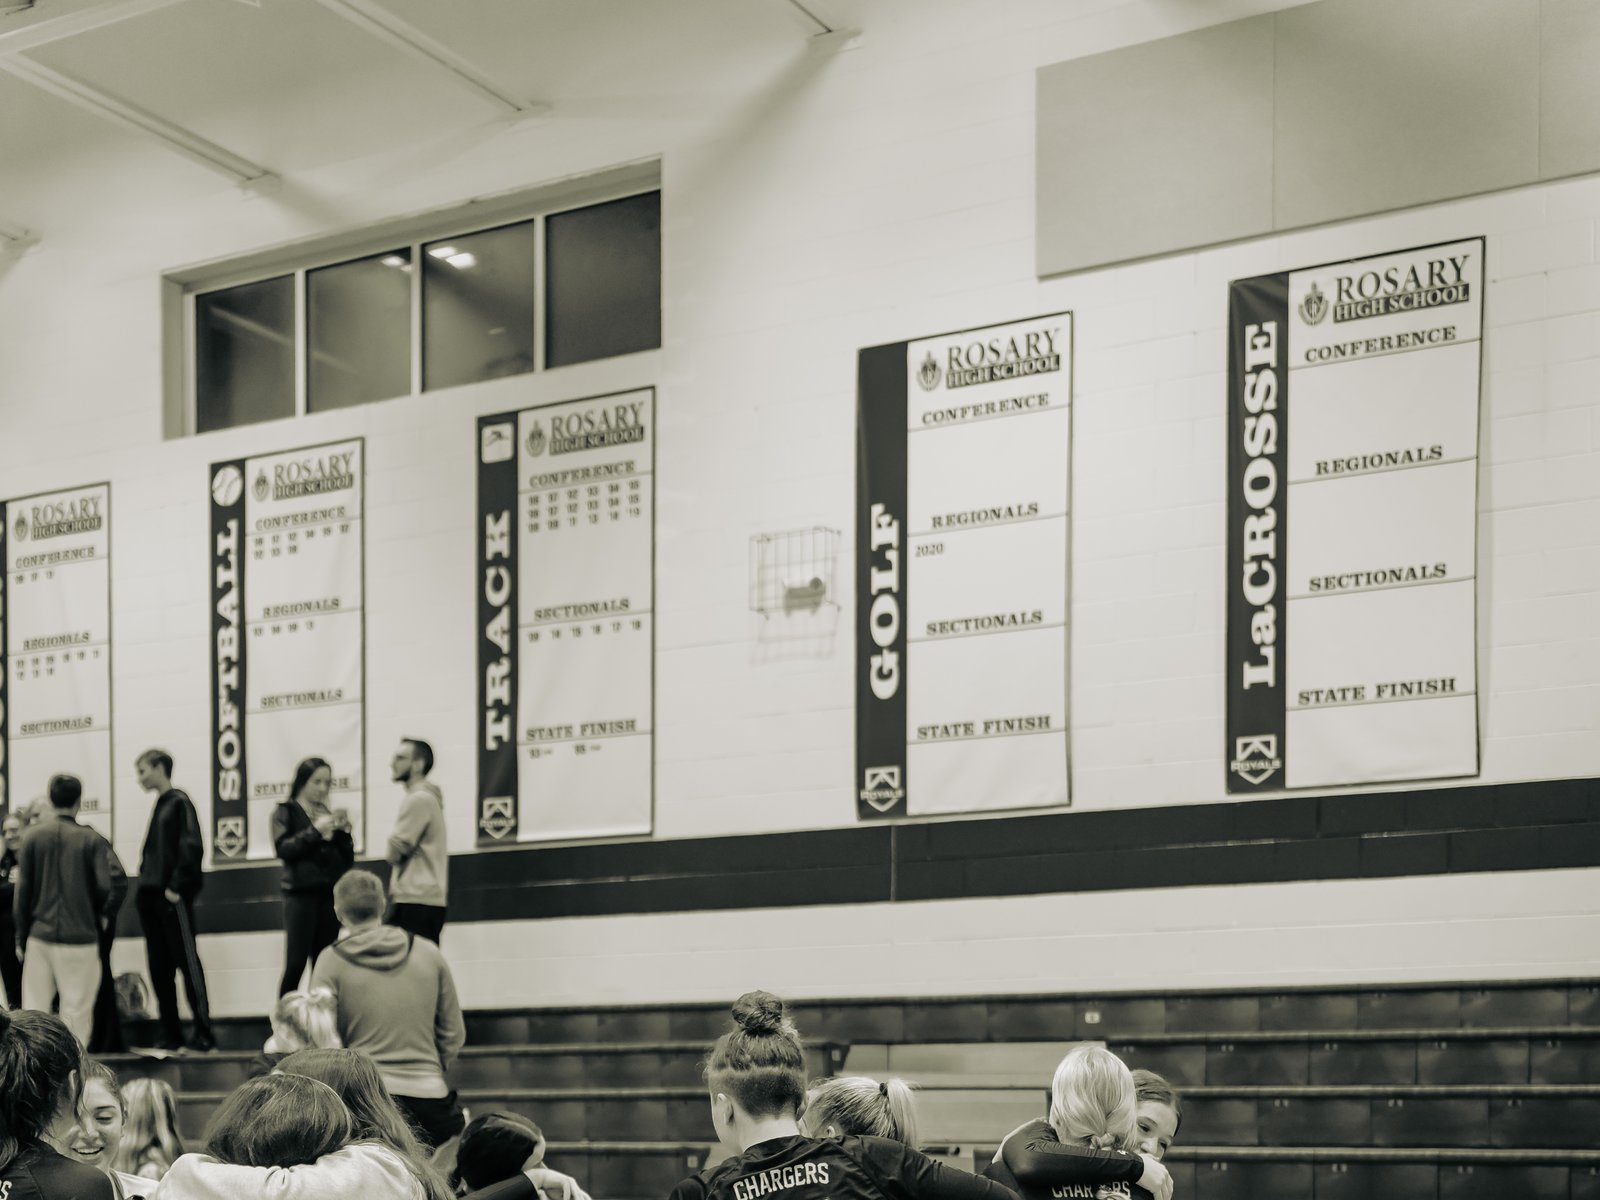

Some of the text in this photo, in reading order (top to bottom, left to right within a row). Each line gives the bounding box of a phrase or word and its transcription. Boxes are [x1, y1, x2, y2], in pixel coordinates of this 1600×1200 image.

[1336, 254, 1470, 302] ROSARY
[1334, 284, 1470, 322] HIGH SCHOOL
[947, 328, 1060, 371] ROSARY
[1304, 326, 1457, 363] CONFERENCE
[946, 355, 1060, 389] HIGH SCHOOL
[551, 401, 644, 440] ROSARY
[922, 393, 1050, 425] CONFERENCE
[274, 451, 353, 485] ROSARY
[529, 460, 635, 489] CONFERENCE
[1315, 445, 1443, 476] REGIONALS
[31, 496, 102, 525] ROSARY
[255, 505, 346, 531] CONFERENCE
[931, 502, 1039, 529] REGIONALS
[1242, 321, 1278, 690] LaCROSSE
[15, 547, 95, 569] CONFERENCE
[915, 543, 944, 557] 2020
[1309, 563, 1448, 592] SECTIONALS
[263, 598, 340, 618] REGIONALS
[534, 599, 630, 621] SECTIONALS
[870, 503, 900, 700] GOLF
[485, 509, 511, 751] TRACK
[926, 610, 1043, 636] SECTIONALS
[23, 632, 90, 650] REGIONALS
[217, 518, 241, 802] SOFTBALL
[260, 689, 343, 708] SECTIONALS
[1298, 677, 1457, 706] STATE FINISH
[20, 717, 92, 735] SECTIONALS
[526, 719, 636, 741] STATE FINISH
[917, 715, 1052, 740] STATE FINISH
[1051, 1181, 1131, 1198] CHARRS
